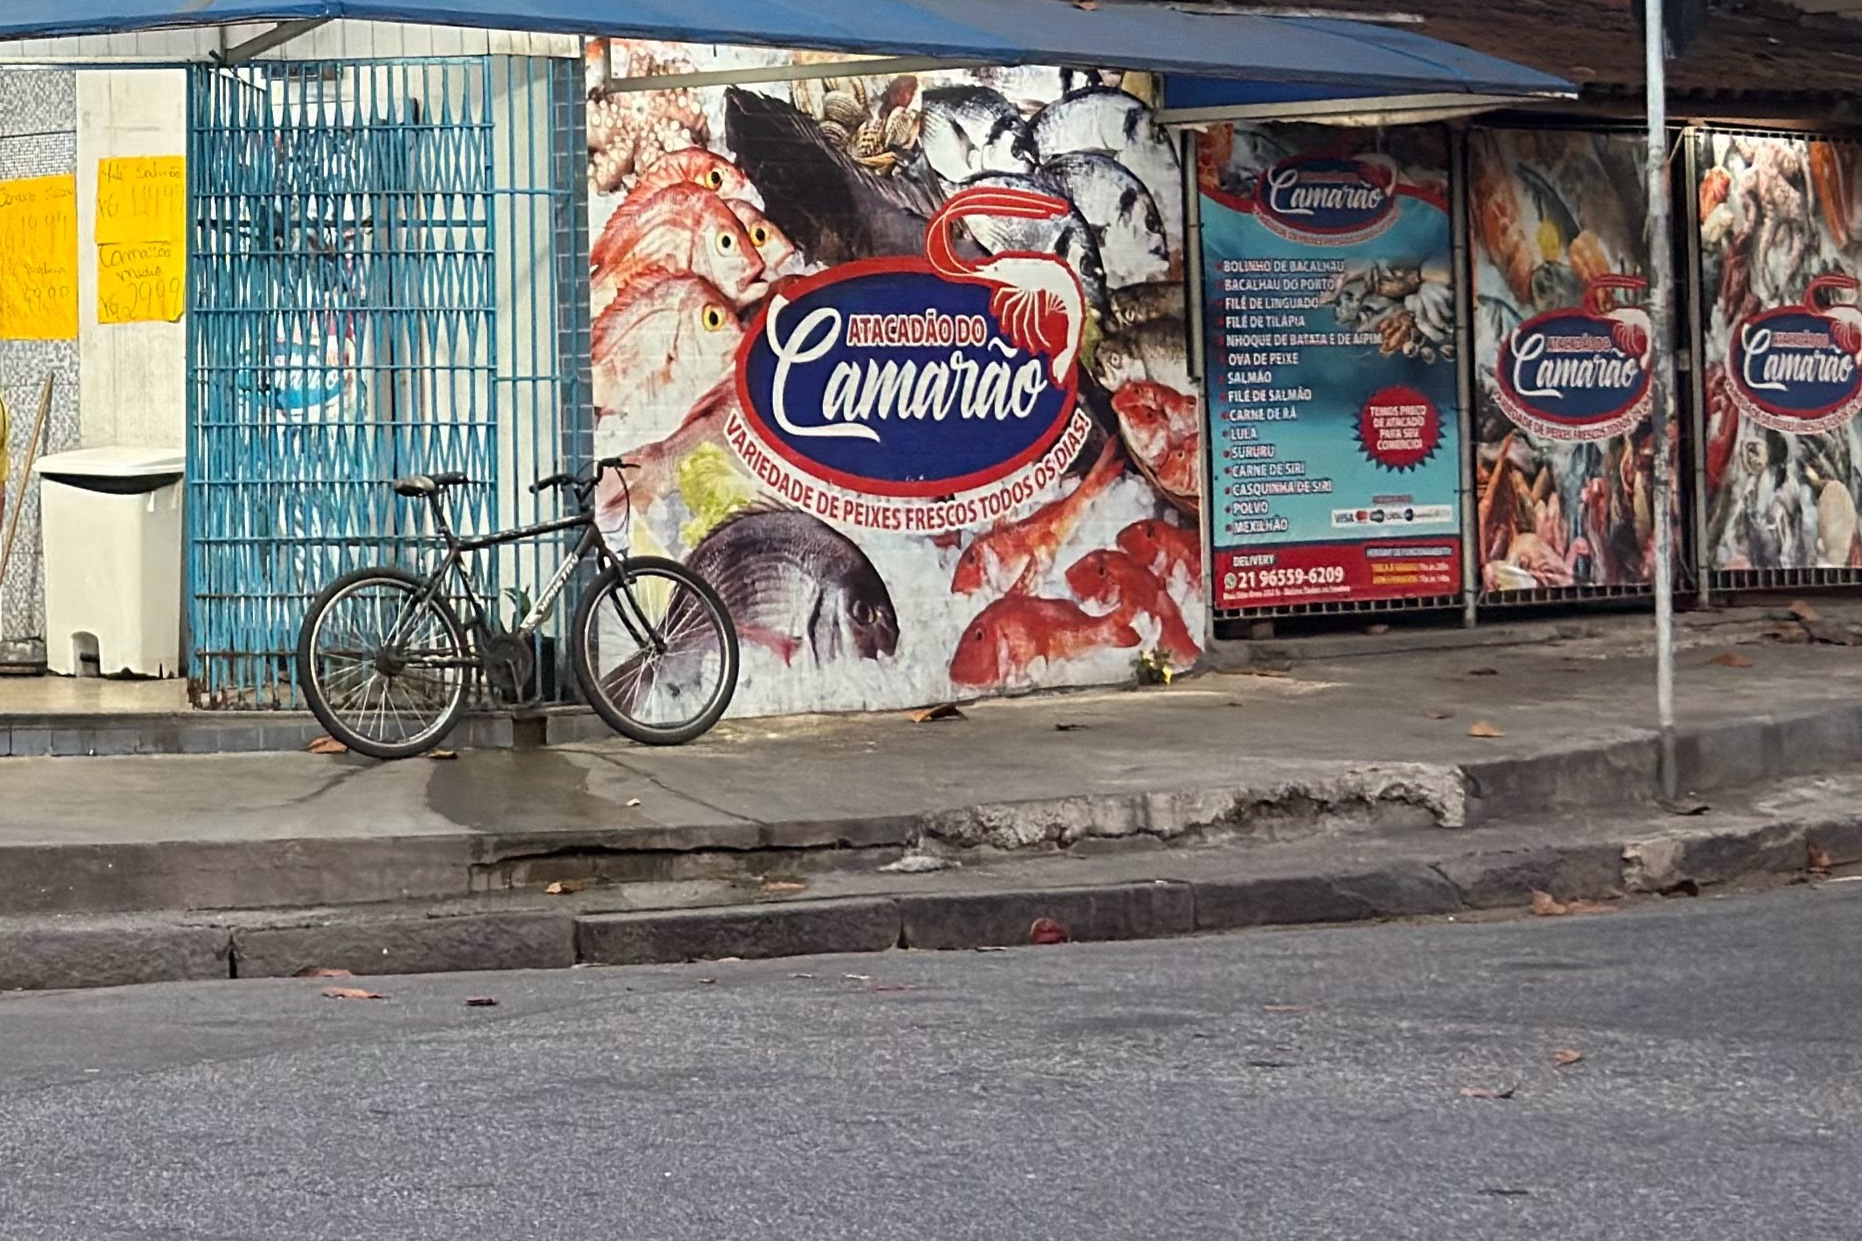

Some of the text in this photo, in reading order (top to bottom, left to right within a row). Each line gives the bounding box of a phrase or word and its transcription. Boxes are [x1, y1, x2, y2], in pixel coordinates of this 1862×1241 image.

[1268, 165, 1384, 216] Camarão
[1274, 261, 1287, 272] DE
[1290, 260, 1345, 272] BACALHAU
[1225, 278, 1335, 291] BACALHAU DO PORTO
[1225, 295, 1319, 310] FILÉ DE LINGUADO
[847, 309, 988, 346] ATACADÃO DO
[1226, 313, 1305, 329] FILÉ DE TILÁPIA
[1227, 334, 1272, 347] NHOQUE
[1274, 334, 1287, 347] DE
[1290, 333, 1328, 346] BATATA
[1330, 333, 1335, 345] E
[1338, 333, 1351, 345] DE
[1228, 352, 1299, 366] OVA DE PEIXE
[1511, 328, 1639, 399] Camarão
[1741, 323, 1854, 392] Camarão
[766, 294, 1048, 443] Camarão
[1228, 369, 1272, 384] SALMÃO
[1252, 390, 1266, 402] DE
[1270, 386, 1312, 402] SALMÃO
[1229, 409, 1265, 421] CARNE
[1267, 408, 1280, 420] DE
[1231, 428, 1258, 440] LULA
[1231, 445, 1275, 459] SURURU
[725, 411, 1090, 531] VARIEDADE DE PEIXES FRESCOS TODOS OS DIAS!
[1232, 462, 1305, 477] CARNE DE SIRI
[1232, 481, 1295, 497] CASQUINHA
[1297, 481, 1310, 494] DE
[1233, 502, 1269, 516] POLVO
[1233, 554, 1275, 566] DELIVERY
[1239, 566, 1344, 589] 21 96559-6209
